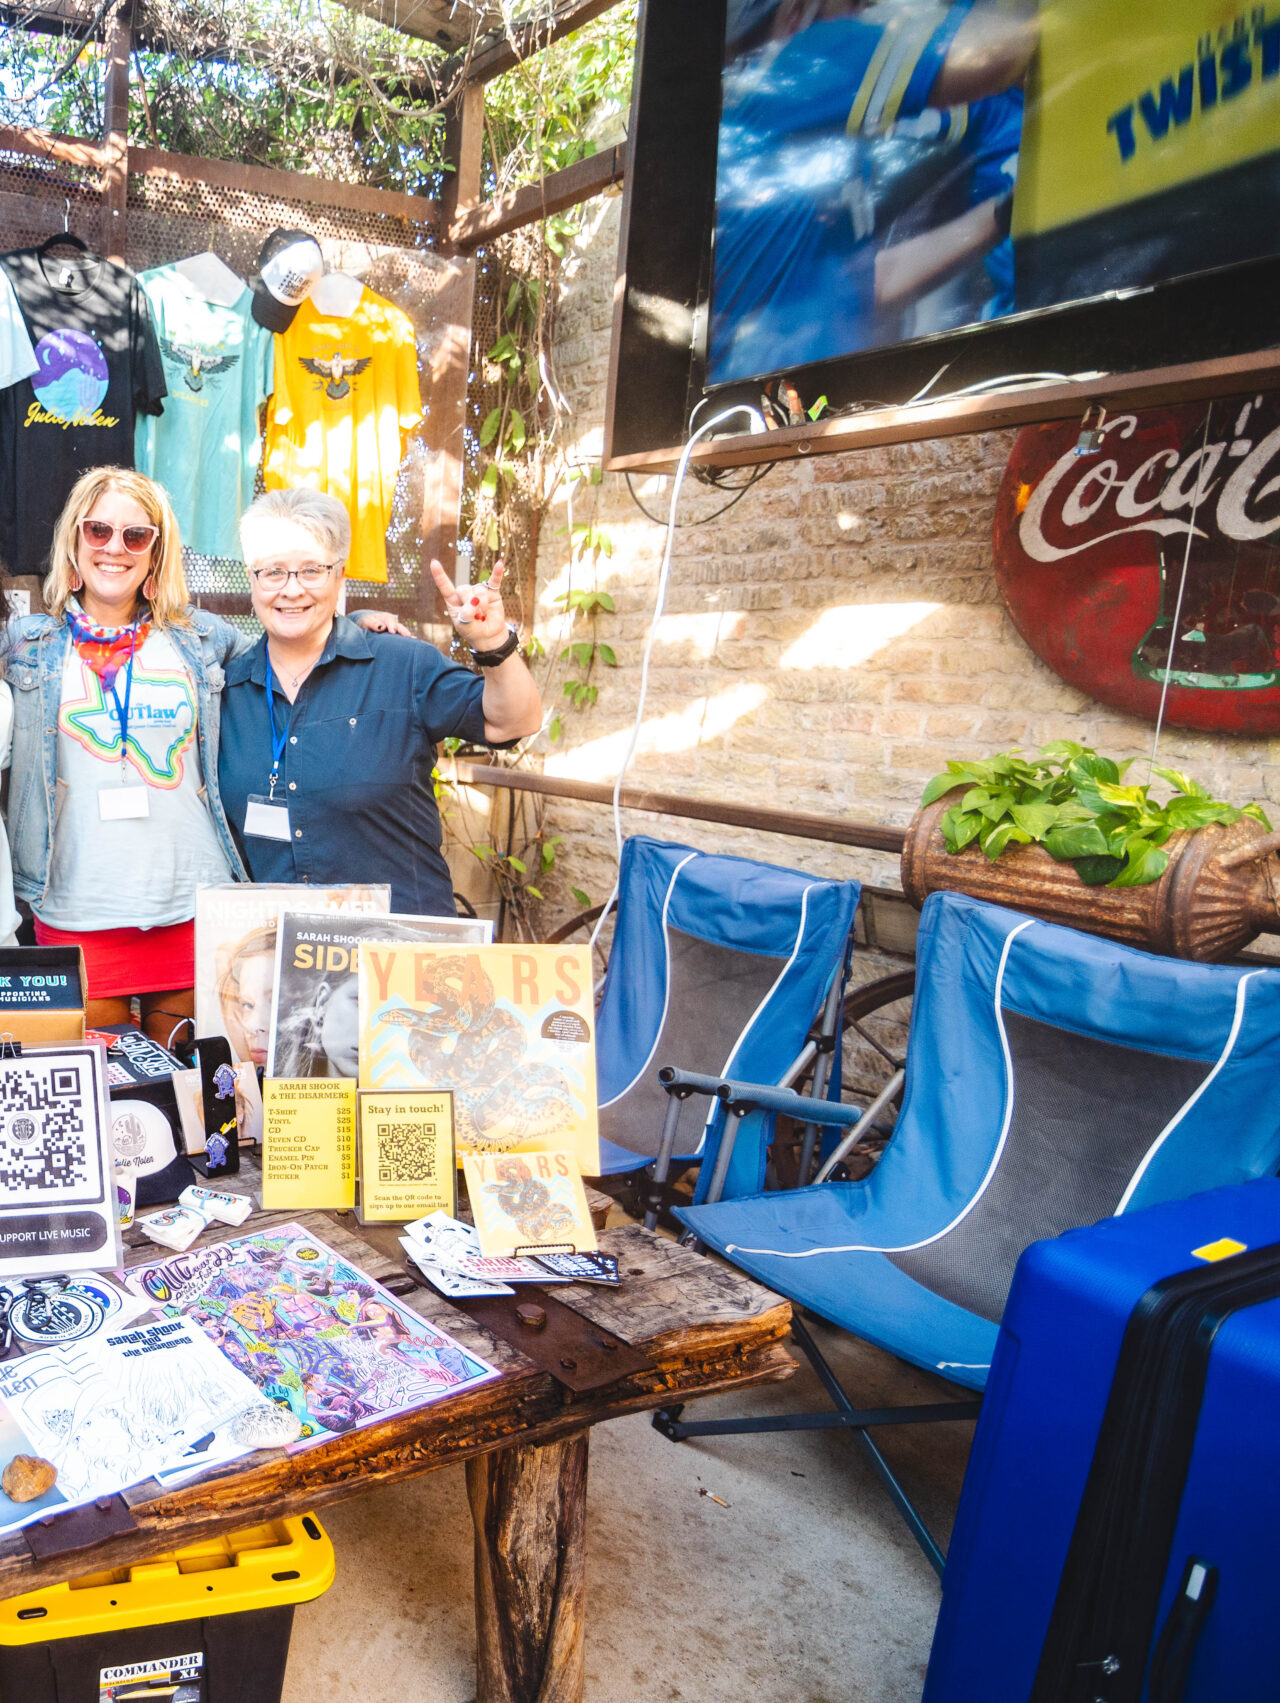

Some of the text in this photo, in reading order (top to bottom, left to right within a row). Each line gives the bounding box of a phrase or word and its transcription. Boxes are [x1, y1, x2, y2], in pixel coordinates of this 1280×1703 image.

[23, 401, 65, 428] Julie
[297, 931, 331, 943] SARAH
[20, 975, 68, 987] YOU!
[370, 951, 581, 1006] YEARS
[368, 1104, 444, 1116] Stay in touch!
[473, 1154, 569, 1182] YEARS
[38, 1229, 59, 1242] LIVE
[60, 1227, 91, 1240] MUSIC
[467, 1258, 517, 1267] SARAH
[104, 1655, 198, 1679] COMMANDER
[180, 1668, 198, 1679] XL
